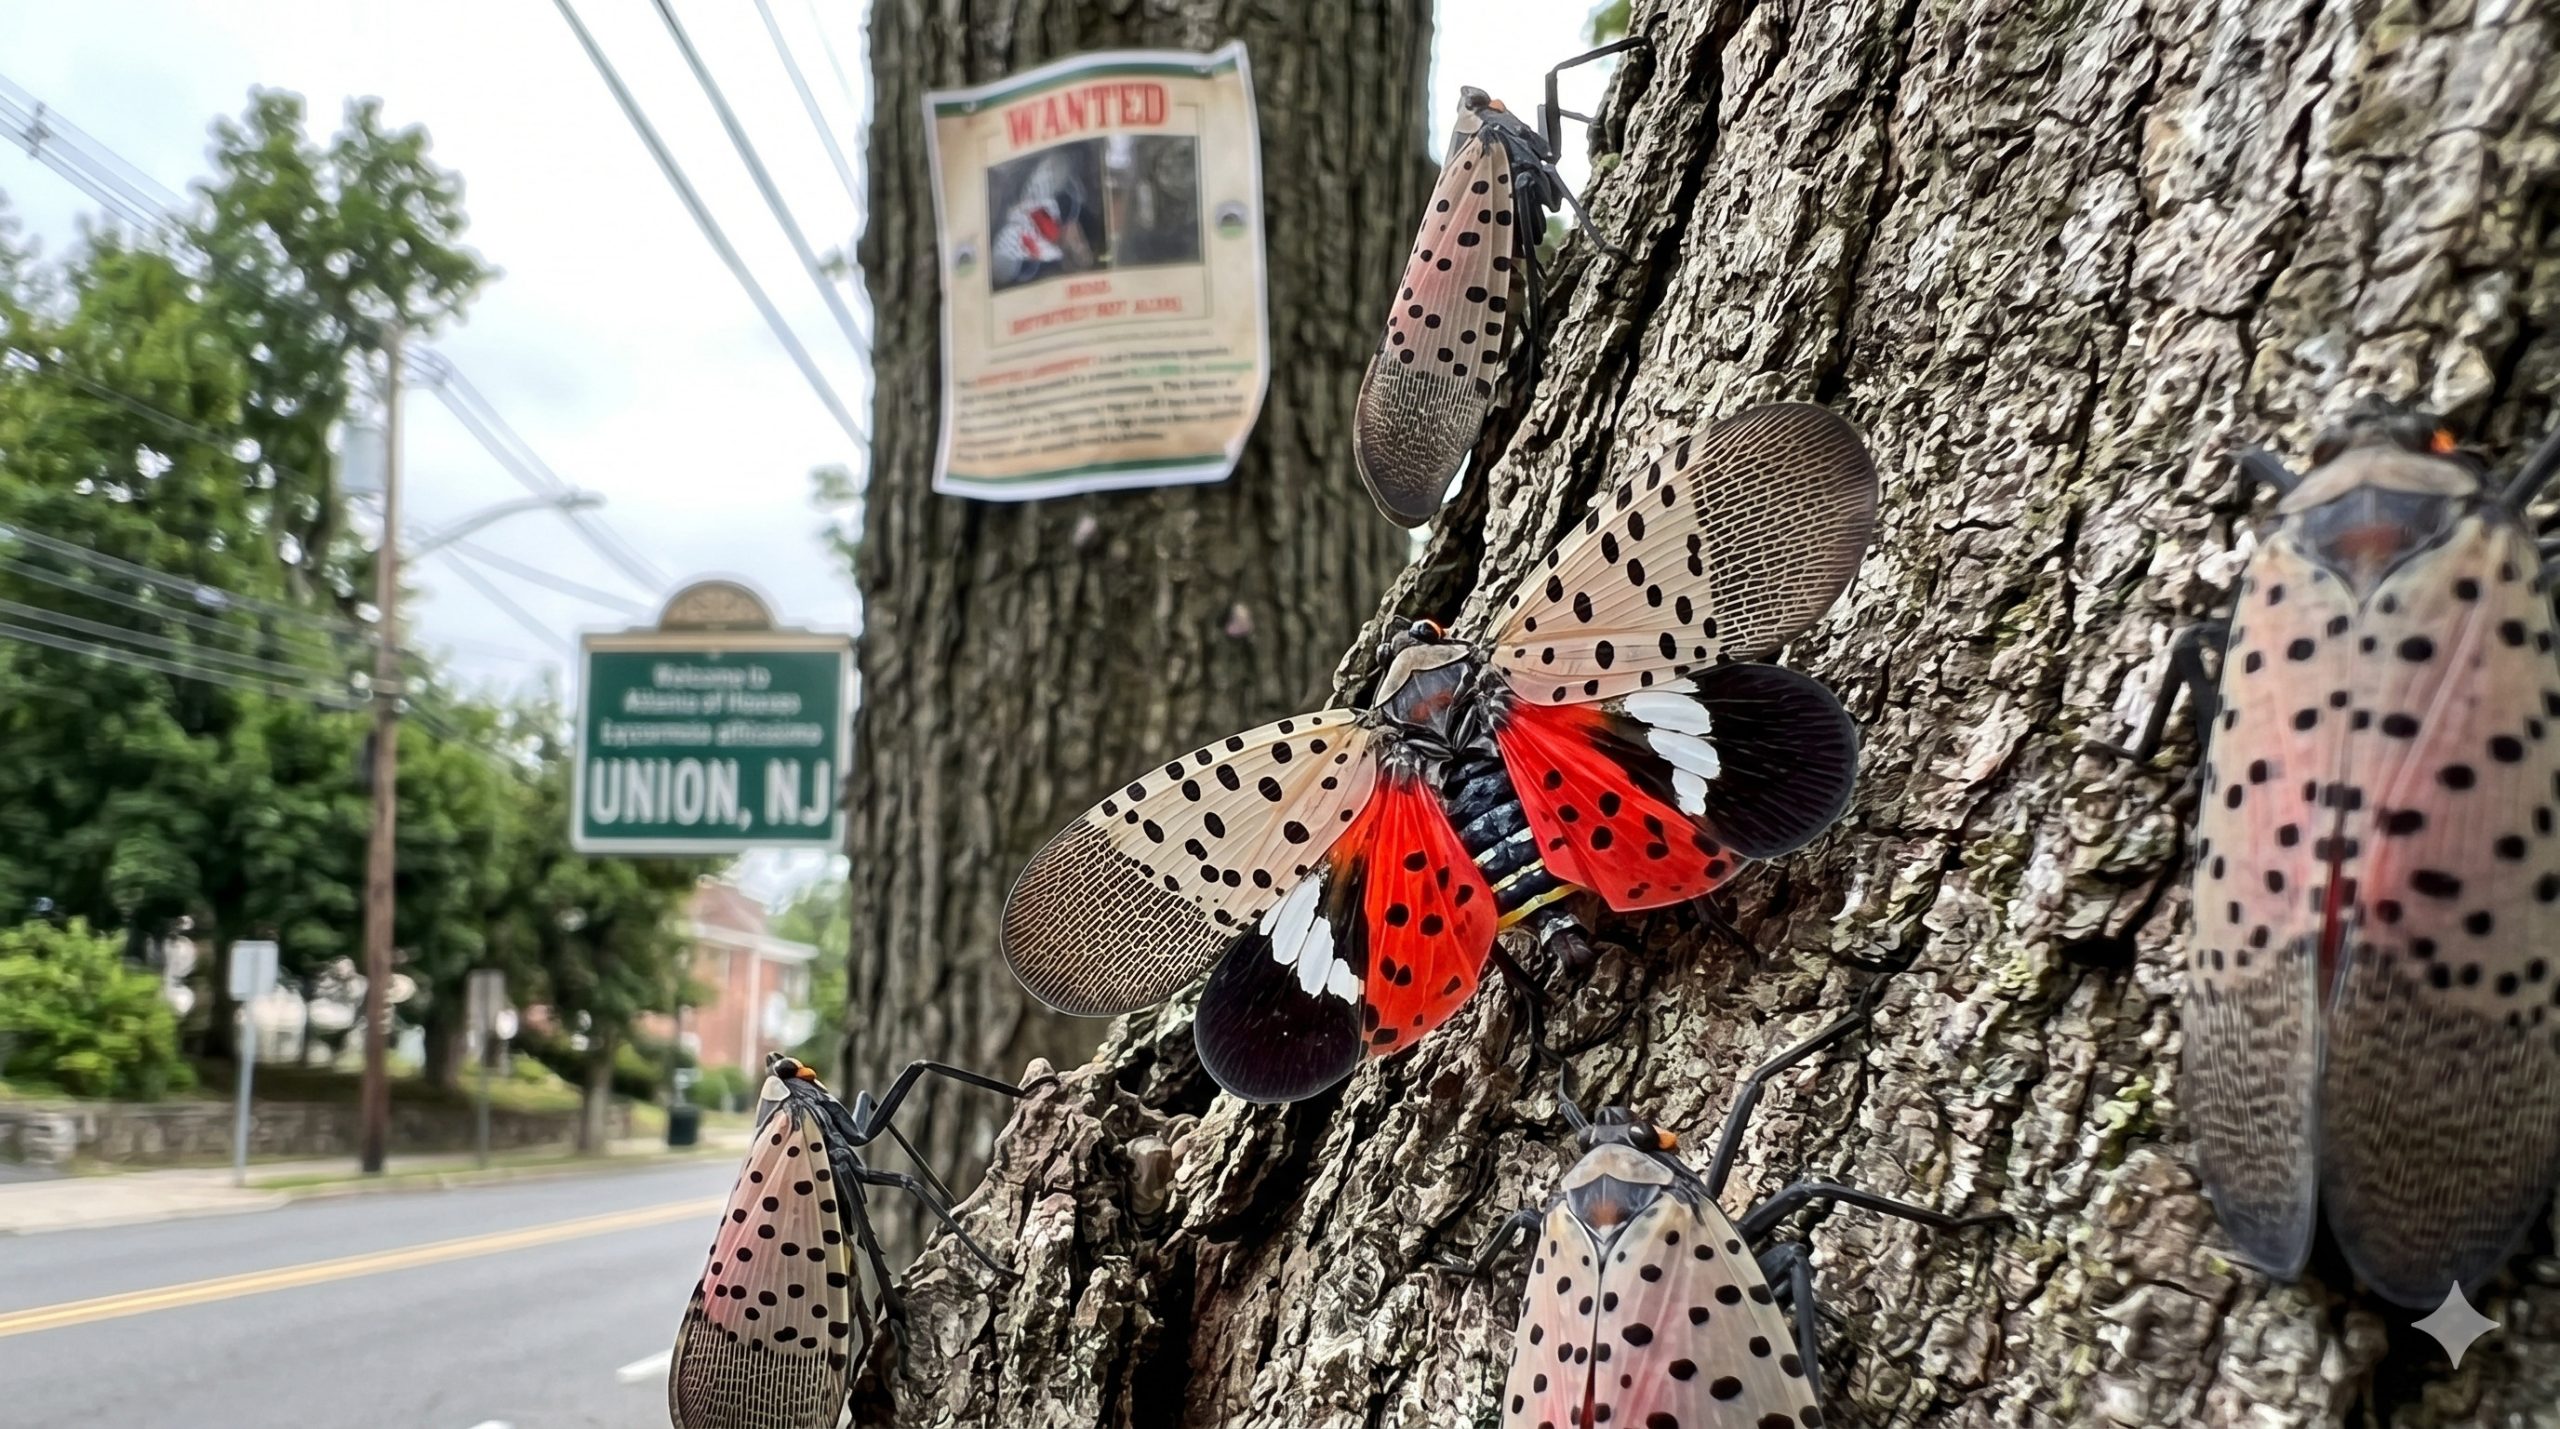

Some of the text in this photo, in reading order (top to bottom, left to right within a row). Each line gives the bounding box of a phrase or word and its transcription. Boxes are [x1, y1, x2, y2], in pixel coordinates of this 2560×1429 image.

[1006, 82, 1166, 147] WANTED
[590, 756, 831, 831] UNION, NJ
